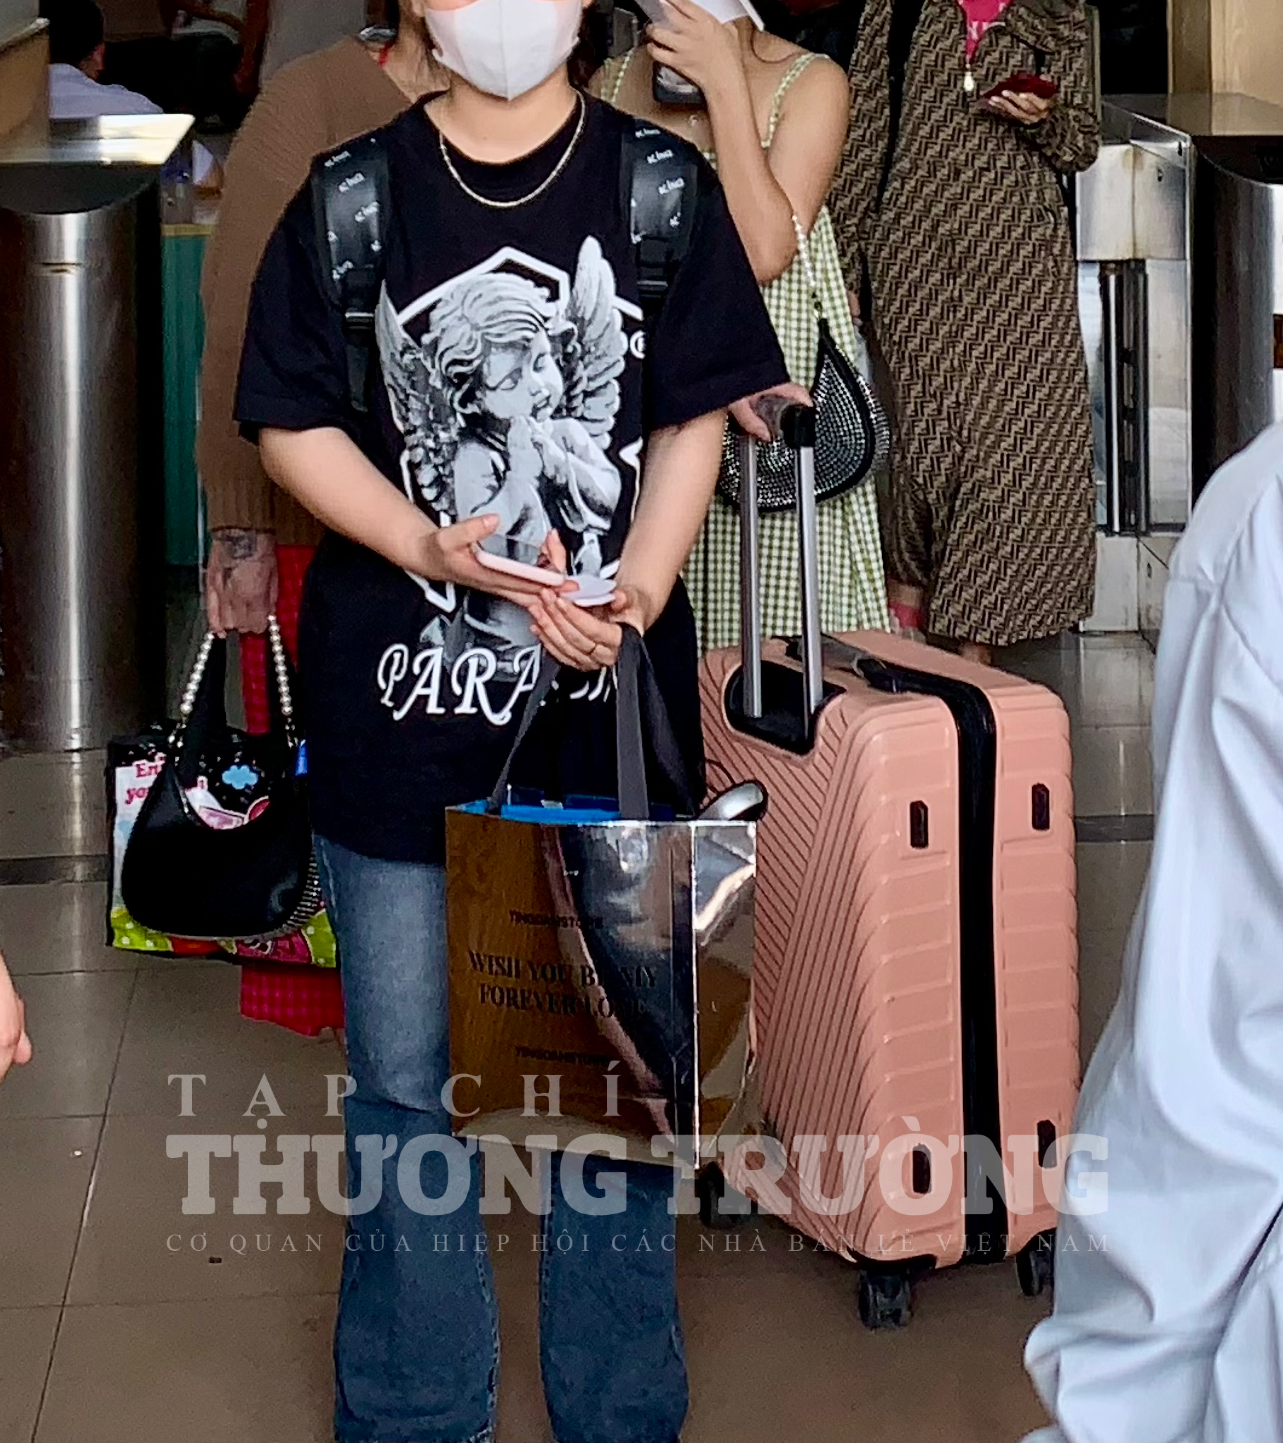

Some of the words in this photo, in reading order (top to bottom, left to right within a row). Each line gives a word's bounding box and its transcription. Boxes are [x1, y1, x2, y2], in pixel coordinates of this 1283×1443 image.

[377, 643, 615, 726] PARA
[468, 950, 522, 980] WISH
[526, 960, 574, 984] YOU
